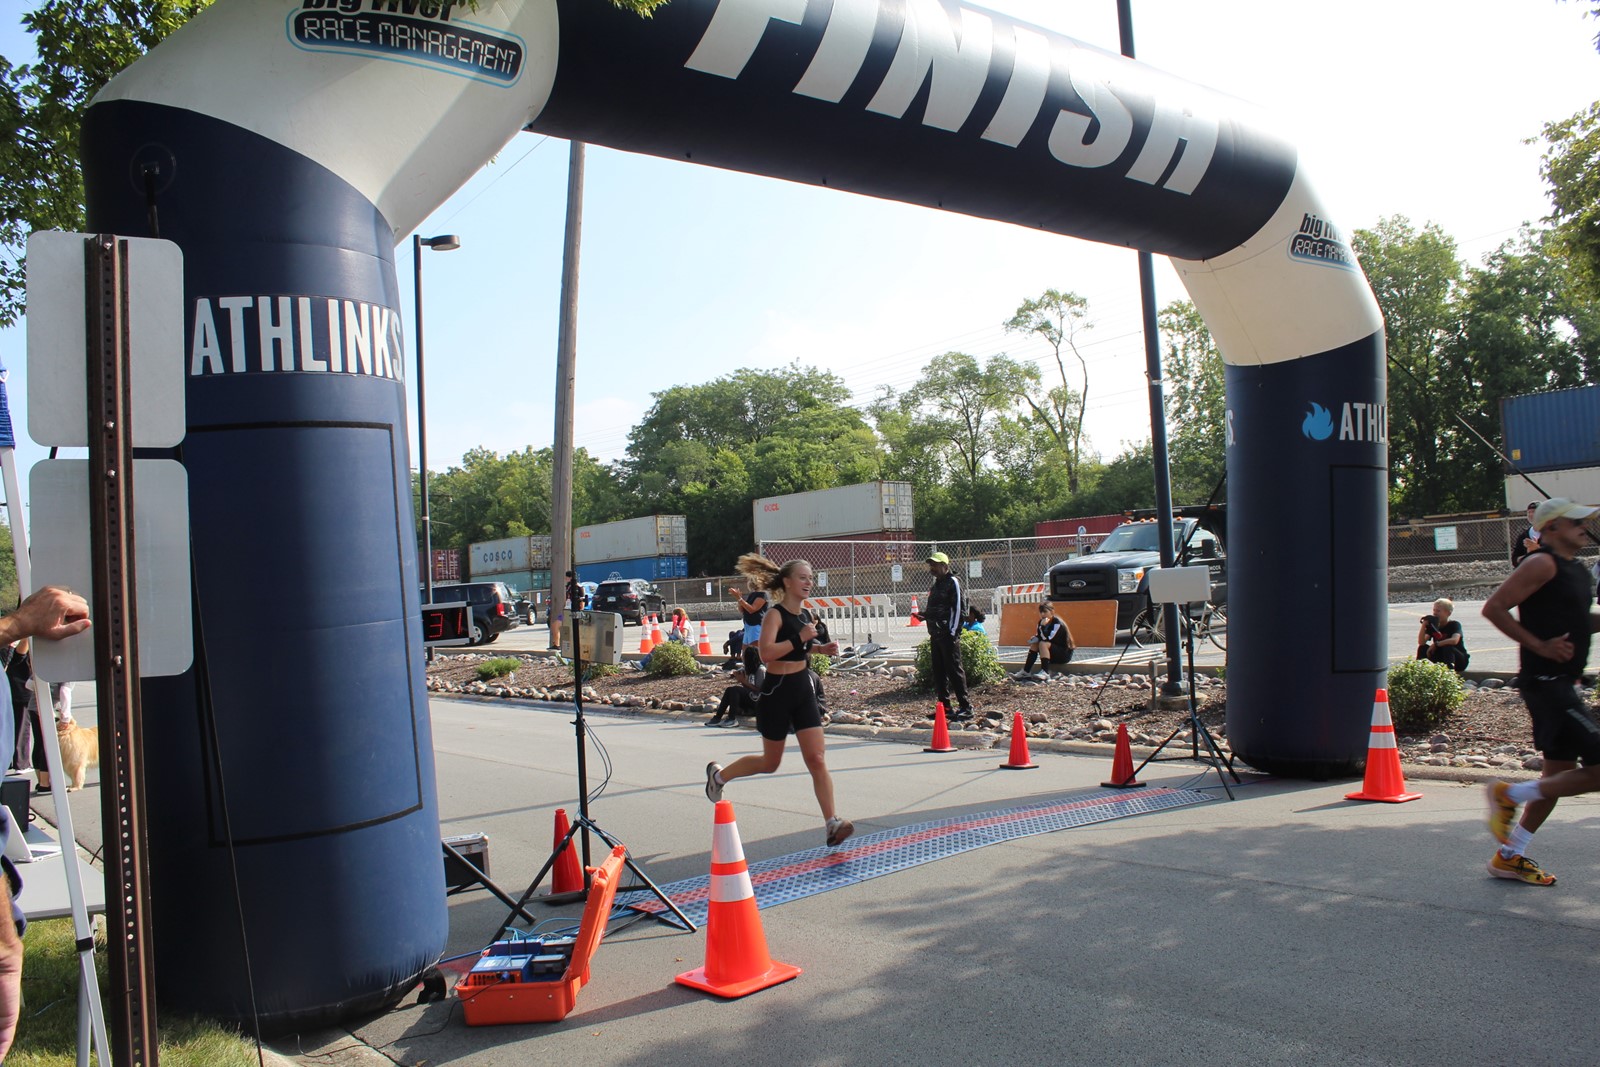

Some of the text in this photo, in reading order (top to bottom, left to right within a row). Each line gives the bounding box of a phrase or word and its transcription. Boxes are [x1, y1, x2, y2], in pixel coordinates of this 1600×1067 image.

[303, 17, 517, 74] RACE MANAGEMENT
[684, 0, 1219, 195] FINISH
[1299, 212, 1323, 238] big
[1294, 239, 1323, 258] RACE
[191, 296, 403, 381] ATHLINKS
[483, 549, 513, 563] COSCO
[429, 612, 462, 638] 31
